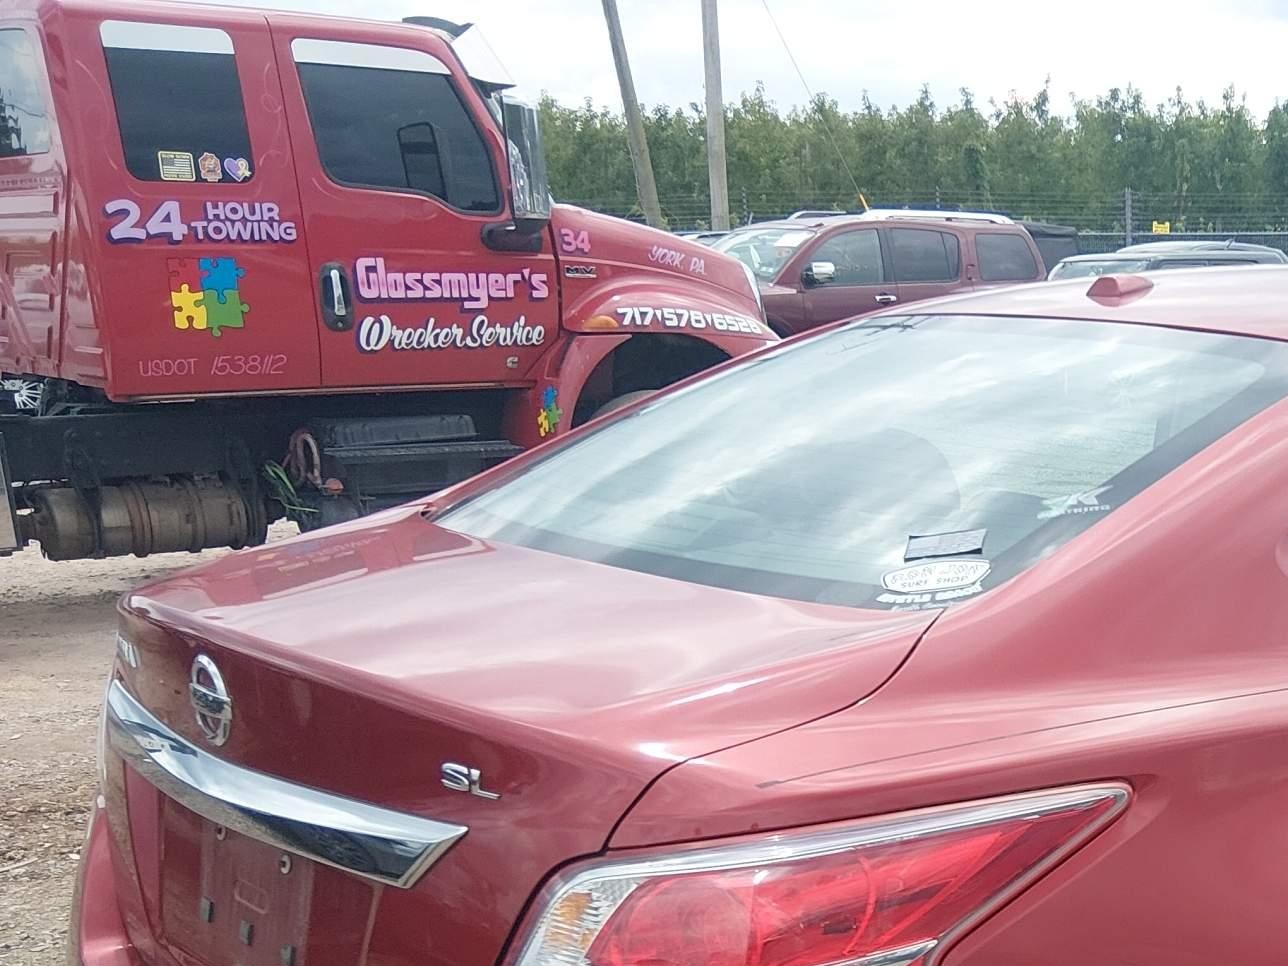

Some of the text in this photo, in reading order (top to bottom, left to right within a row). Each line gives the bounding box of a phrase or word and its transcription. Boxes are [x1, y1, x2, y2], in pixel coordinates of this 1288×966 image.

[104, 199, 280, 242] 24 HOUR
[190, 221, 297, 242] TOWING
[559, 227, 591, 253] 34
[355, 257, 549, 309] Glassmyer's
[358, 315, 545, 351] Wrecker Service
[139, 354, 288, 377] USDOT 1538112
[440, 762, 502, 800] SL
